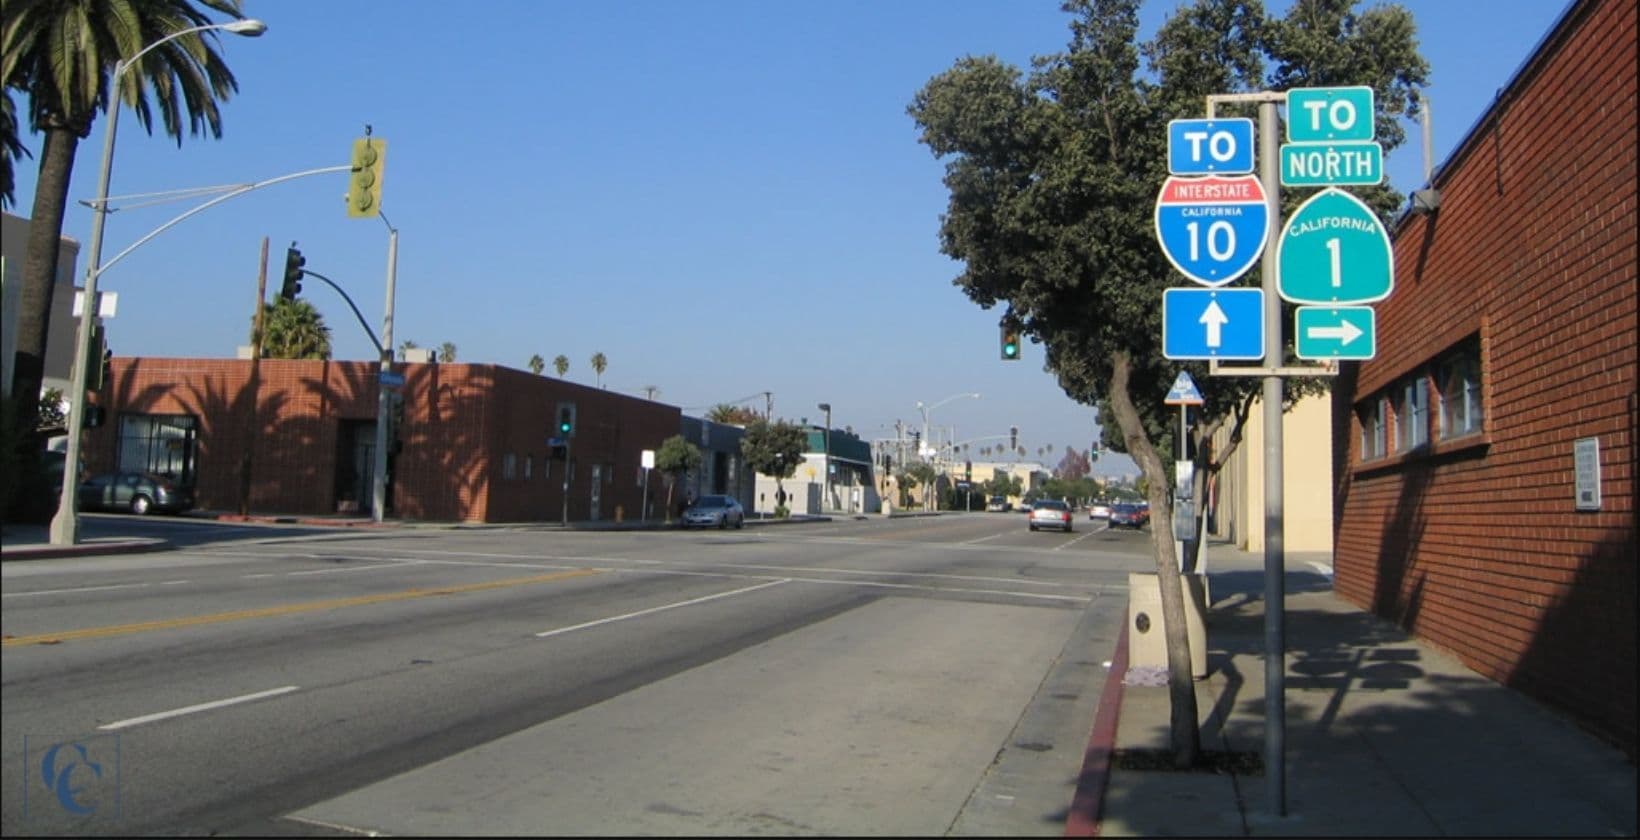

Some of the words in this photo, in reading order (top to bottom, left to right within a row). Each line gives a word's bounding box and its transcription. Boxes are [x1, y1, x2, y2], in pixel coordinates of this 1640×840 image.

[1304, 100, 1357, 131] TO
[1184, 131, 1237, 162] TO
[1290, 151, 1372, 178] NORTH
[1174, 184, 1251, 199] INTERSTATE
[1181, 207, 1242, 217] CALIFORNIA
[1186, 220, 1236, 262] 10
[1289, 217, 1376, 237] CALIFORNIA
[1326, 238, 1342, 287] 1
